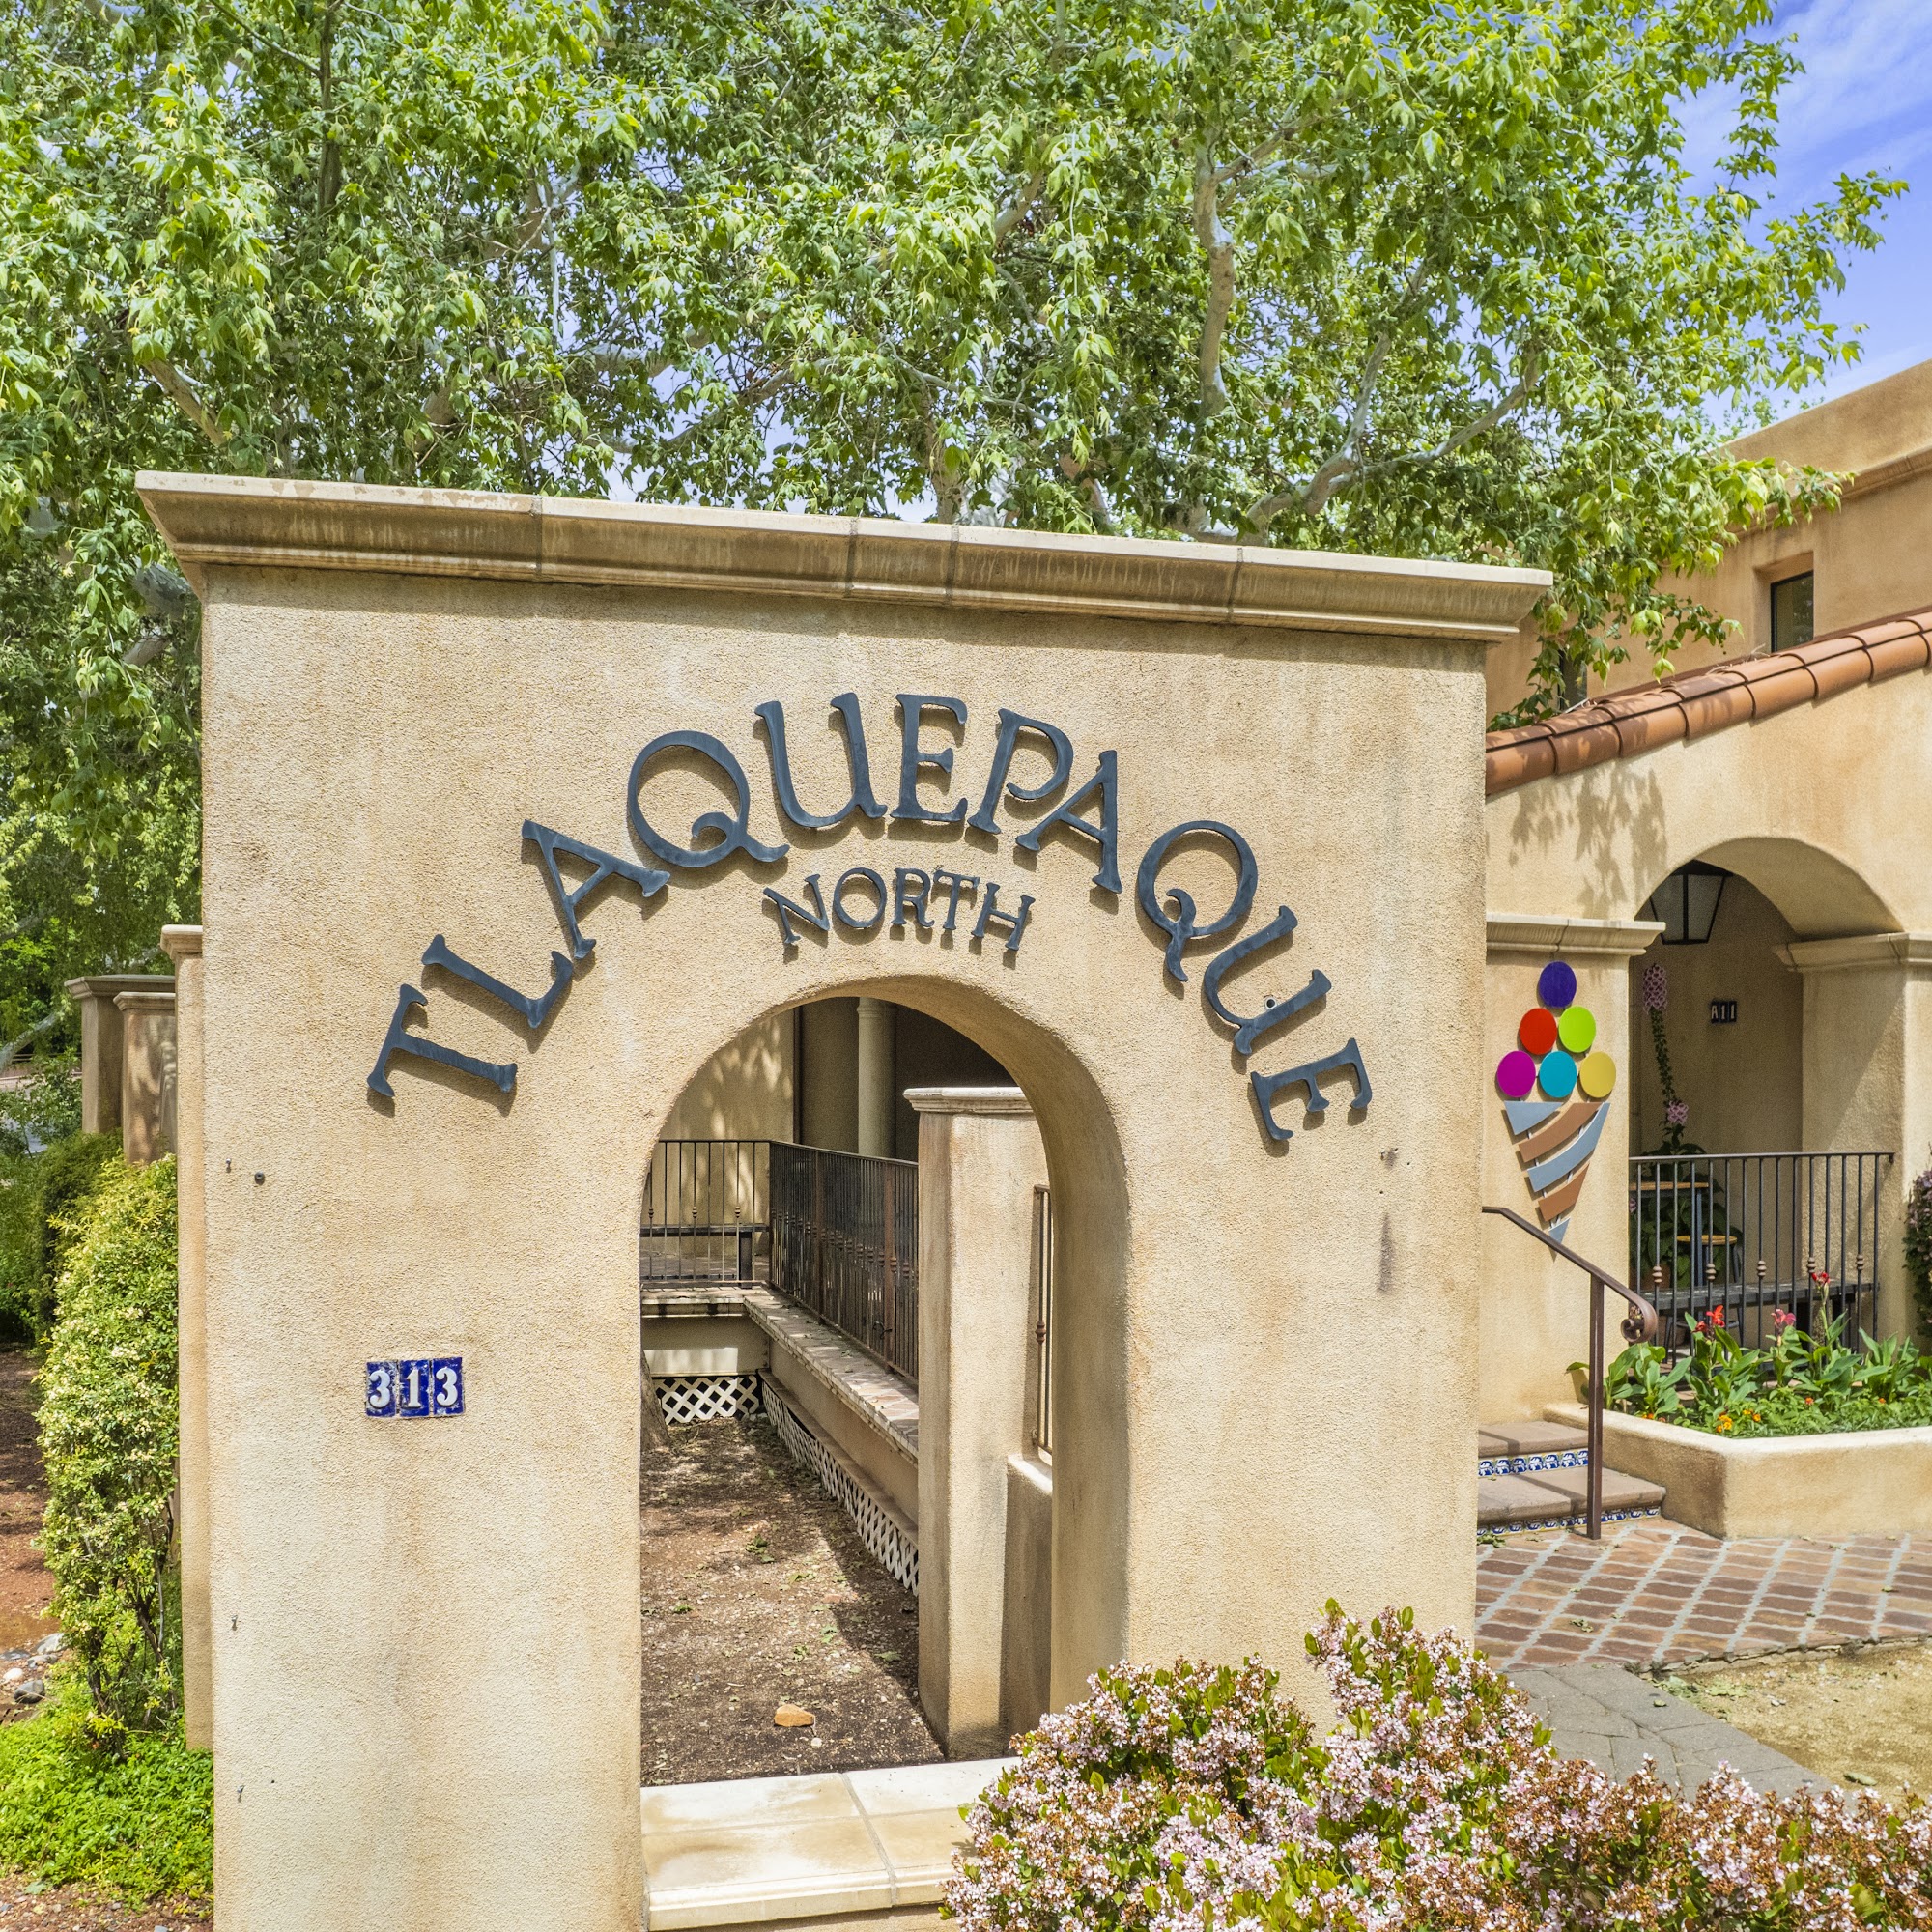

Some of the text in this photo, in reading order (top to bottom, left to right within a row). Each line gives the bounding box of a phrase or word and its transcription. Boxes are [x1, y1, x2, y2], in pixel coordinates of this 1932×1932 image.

[367, 692, 1373, 1140] TLAQUEPAQUE
[762, 867, 1037, 951] NORTH
[1711, 1004, 1735, 1020] A11
[369, 1366, 459, 1408] 313
